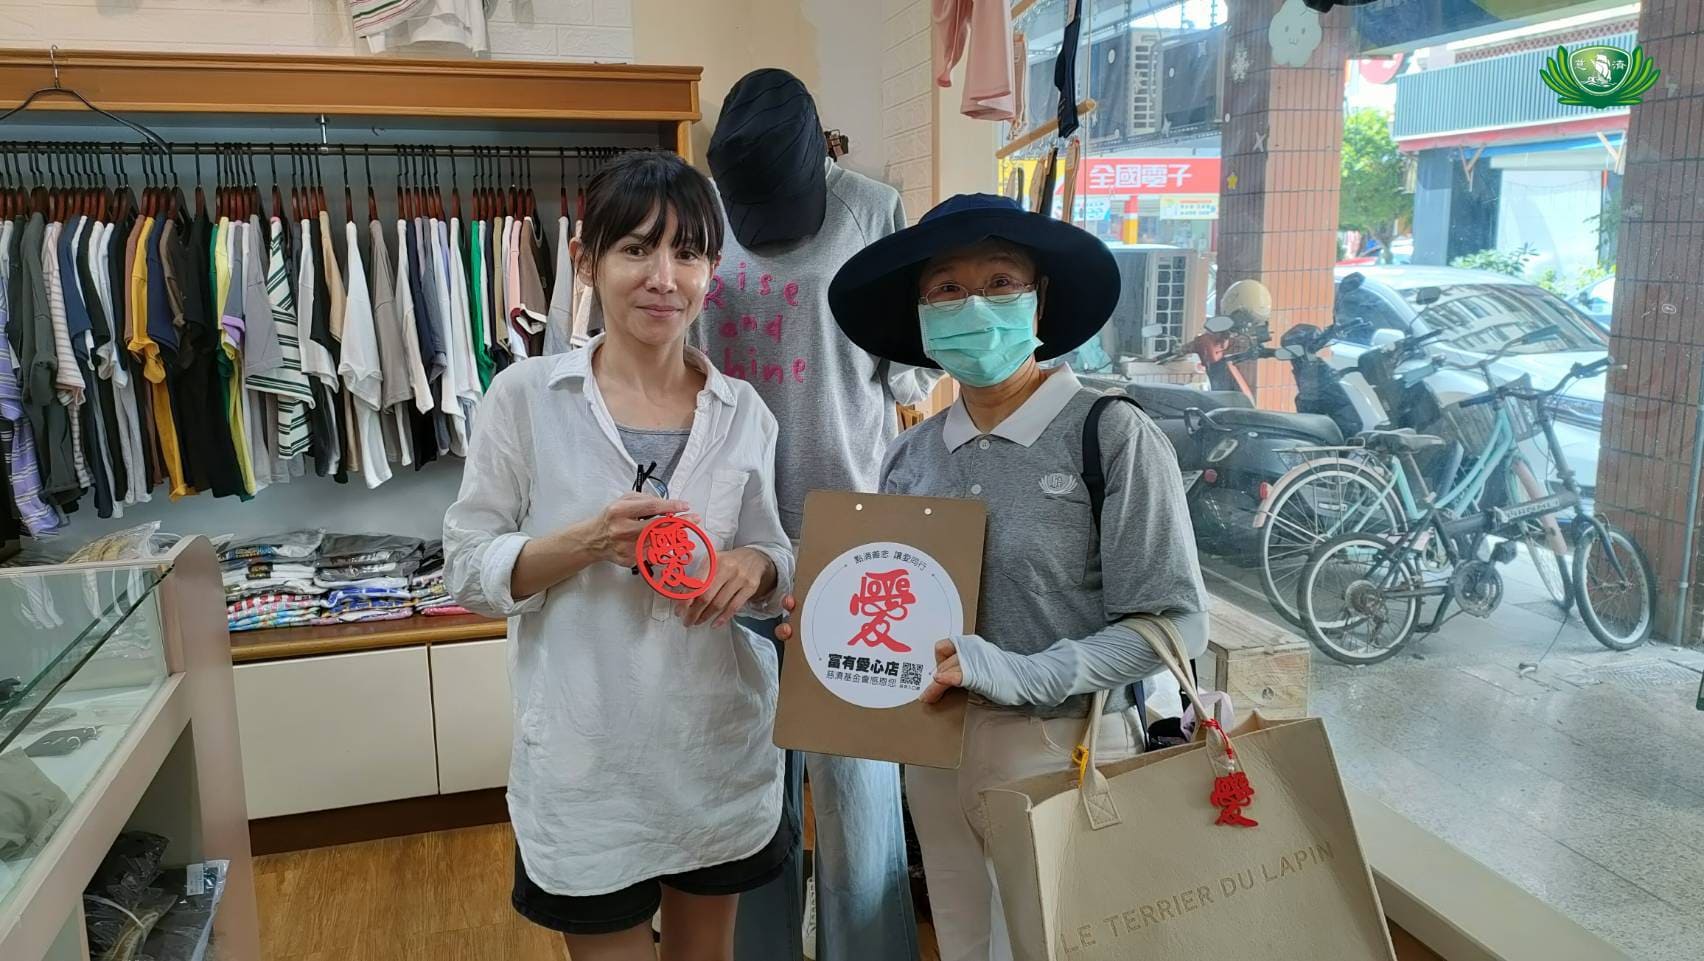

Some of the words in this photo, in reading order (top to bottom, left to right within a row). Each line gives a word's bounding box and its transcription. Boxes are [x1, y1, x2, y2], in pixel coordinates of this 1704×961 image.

[1089, 164, 1192, 189] 全國電子
[703, 261, 799, 307] Rise
[720, 314, 783, 344] and
[702, 345, 806, 384] hine
[826, 670, 897, 688] 慈濟基金會感恩您
[827, 653, 899, 677] 富有愛心店
[1060, 925, 1096, 953] LE
[1103, 885, 1215, 937] TERRIER
[1220, 868, 1254, 898] DU
[1261, 841, 1335, 881] LAPIN
